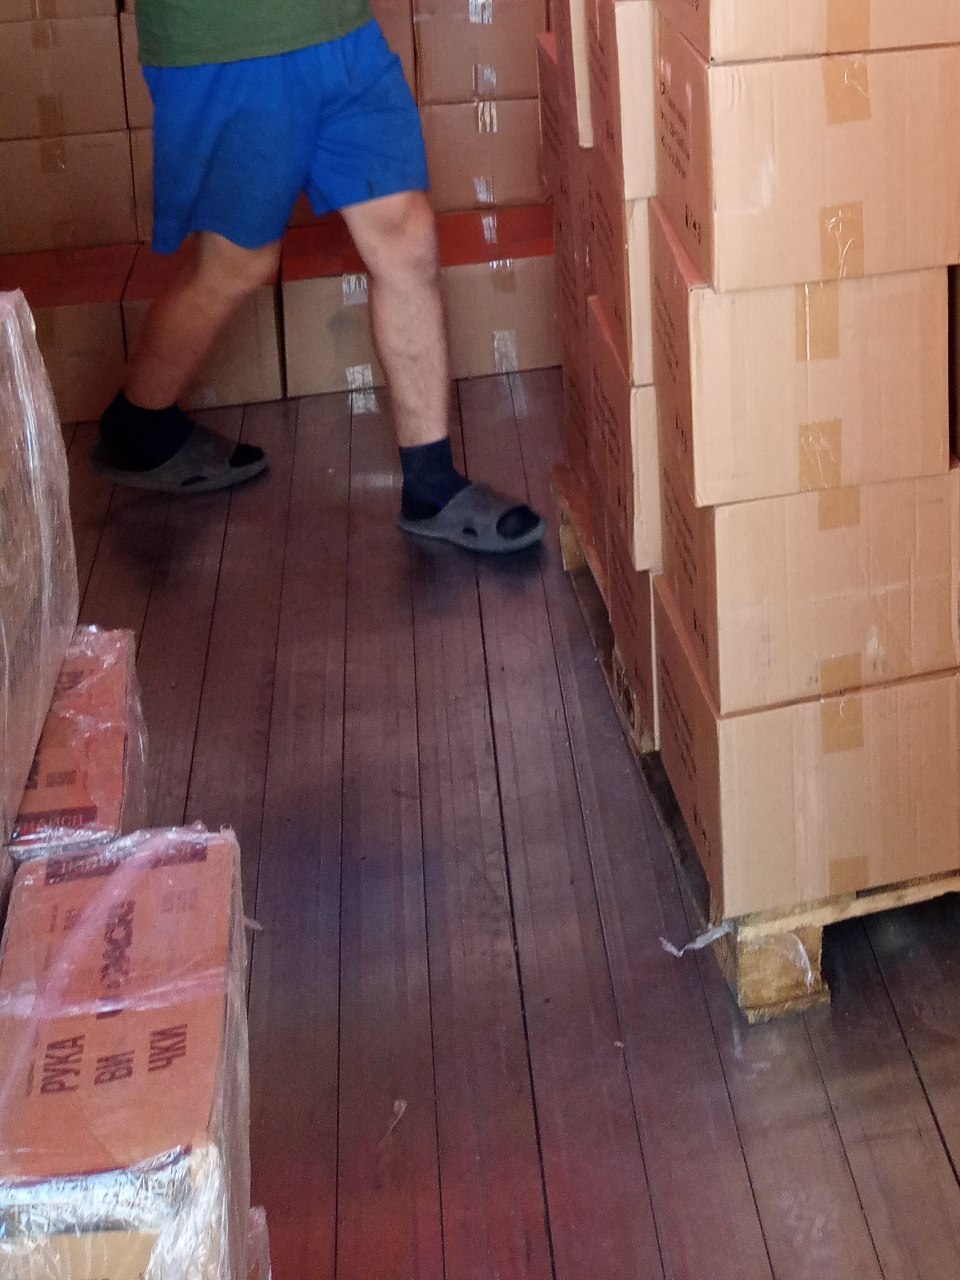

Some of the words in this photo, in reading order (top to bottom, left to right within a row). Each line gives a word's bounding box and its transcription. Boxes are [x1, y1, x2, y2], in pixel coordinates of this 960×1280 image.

[40, 1033, 86, 1098] РУКА
[93, 1049, 136, 1087] ВИ
[146, 1023, 188, 1073] ЧКИ
